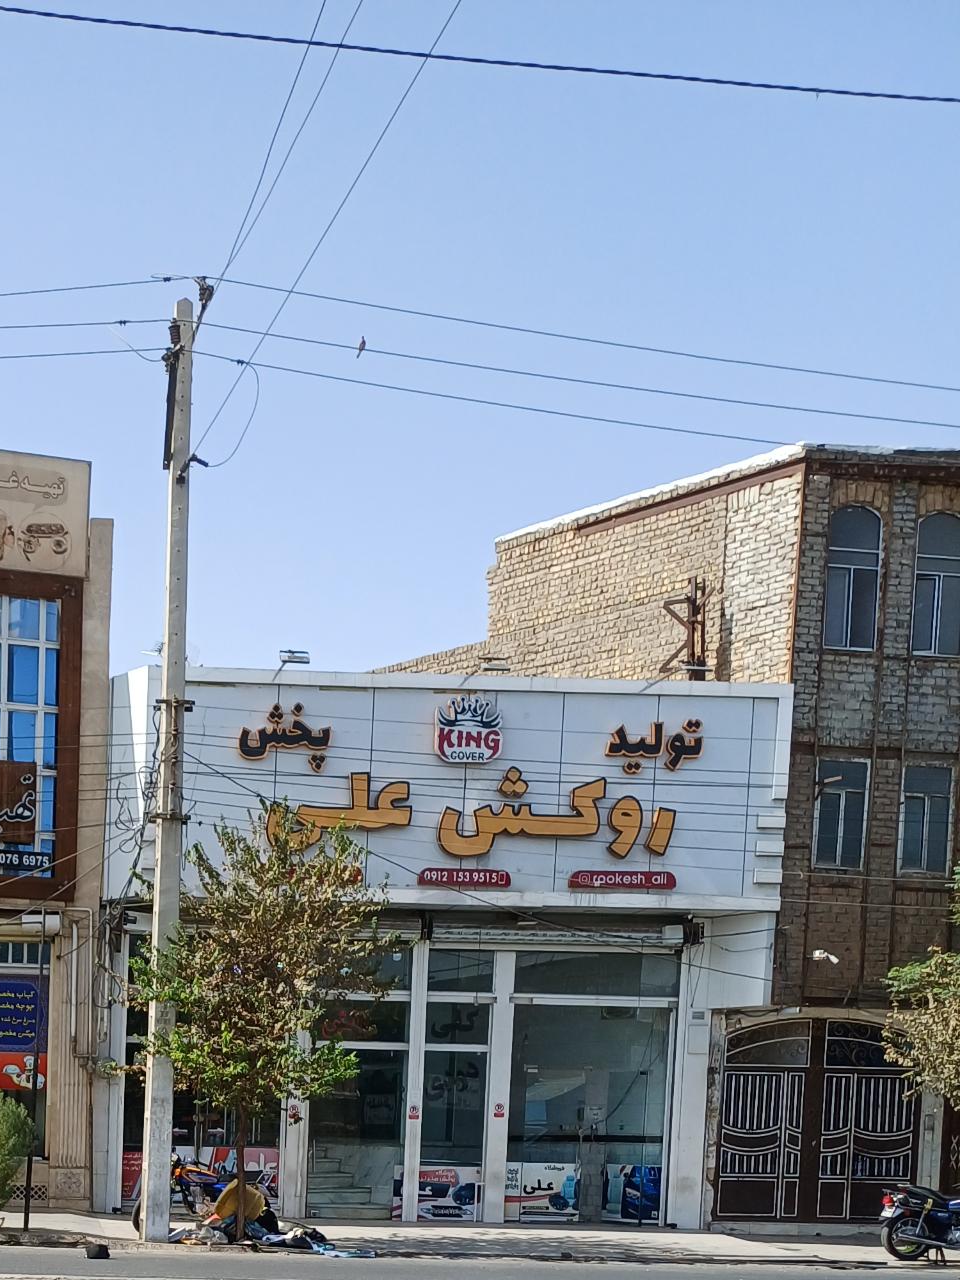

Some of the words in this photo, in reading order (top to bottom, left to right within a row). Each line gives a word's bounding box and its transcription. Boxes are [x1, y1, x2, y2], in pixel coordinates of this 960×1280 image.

[20, 475, 66, 499] تهیه
[238, 702, 332, 773] پخش
[438, 727, 501, 760] KING
[604, 716, 704, 774] تولید
[266, 772, 413, 851] علی
[437, 766, 676, 859] روکش
[22, 855, 50, 868] 6975
[424, 870, 448, 881] 0912
[453, 871, 469, 882] 153
[473, 872, 498, 883] 9515
[523, 1178, 554, 1195] علی
